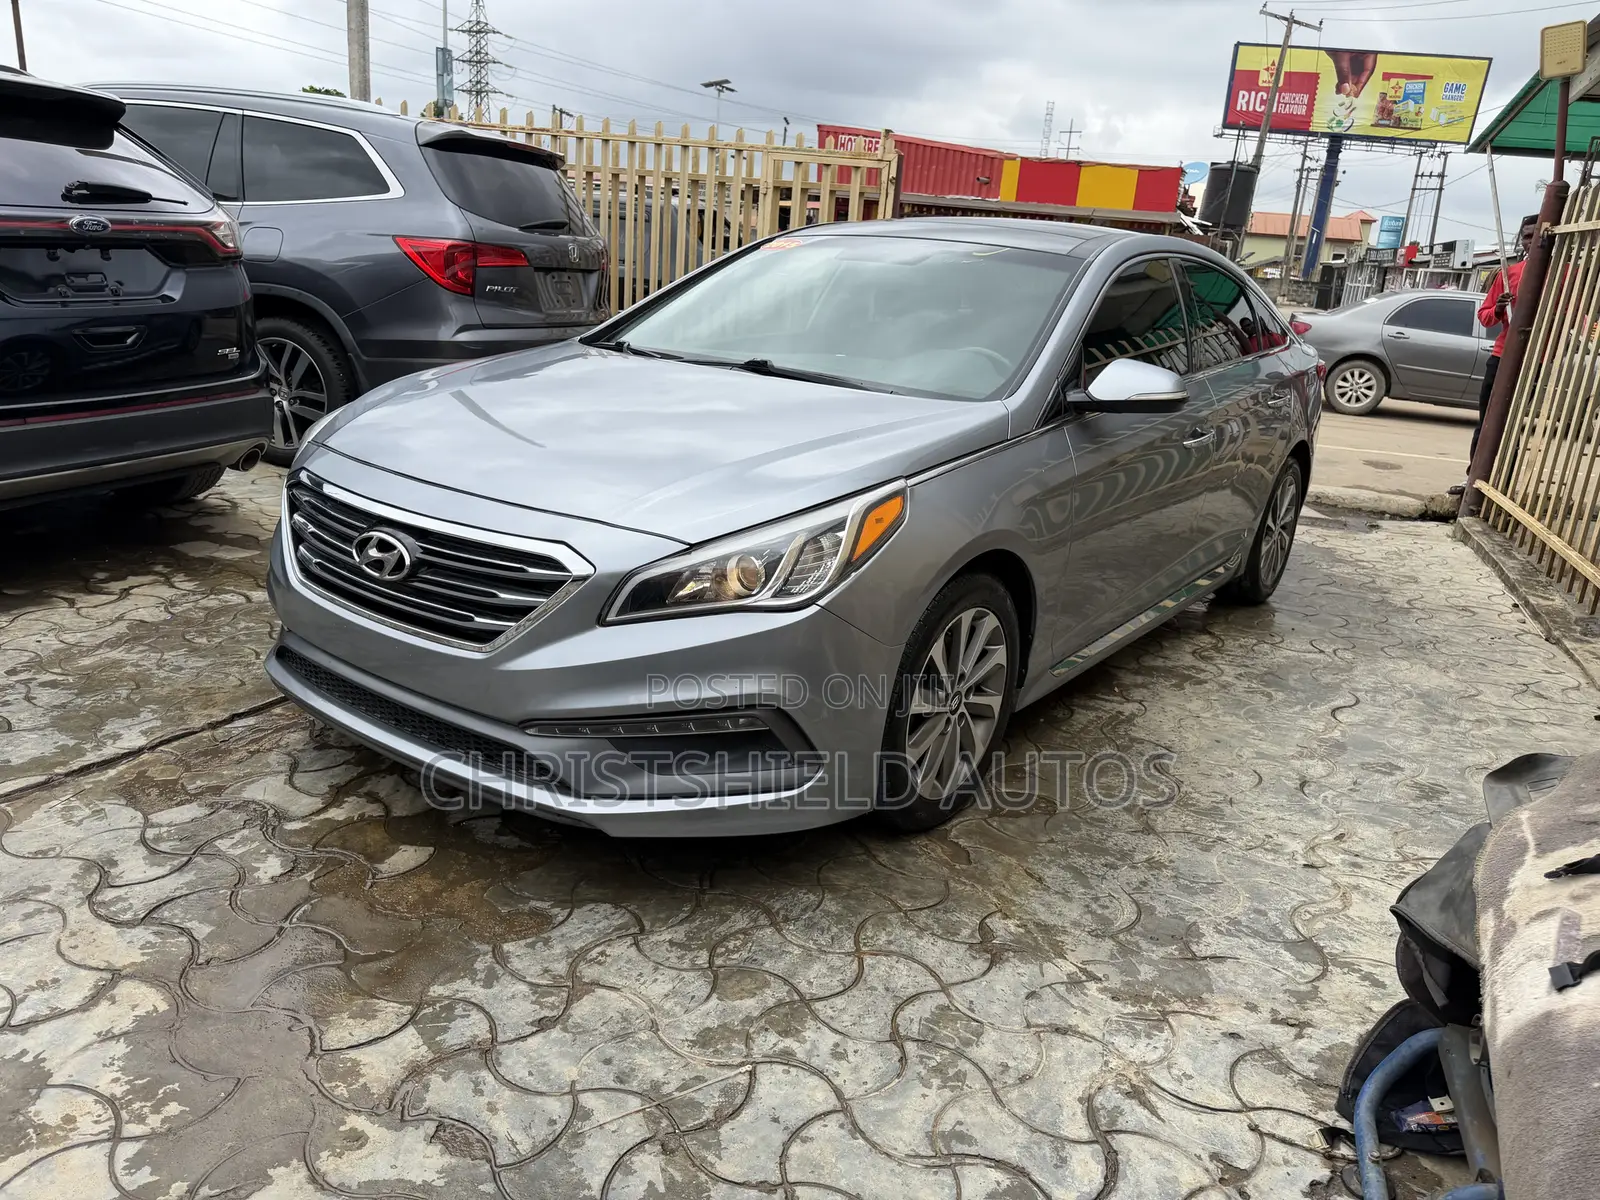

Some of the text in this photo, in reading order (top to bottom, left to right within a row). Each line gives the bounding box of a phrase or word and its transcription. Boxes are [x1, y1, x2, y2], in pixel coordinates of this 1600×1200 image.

[1280, 92, 1309, 105] CHICKEN
[1278, 103, 1307, 115] FLAVOUR
[83, 220, 104, 231] Ford
[485, 285, 519, 293] PILOT
